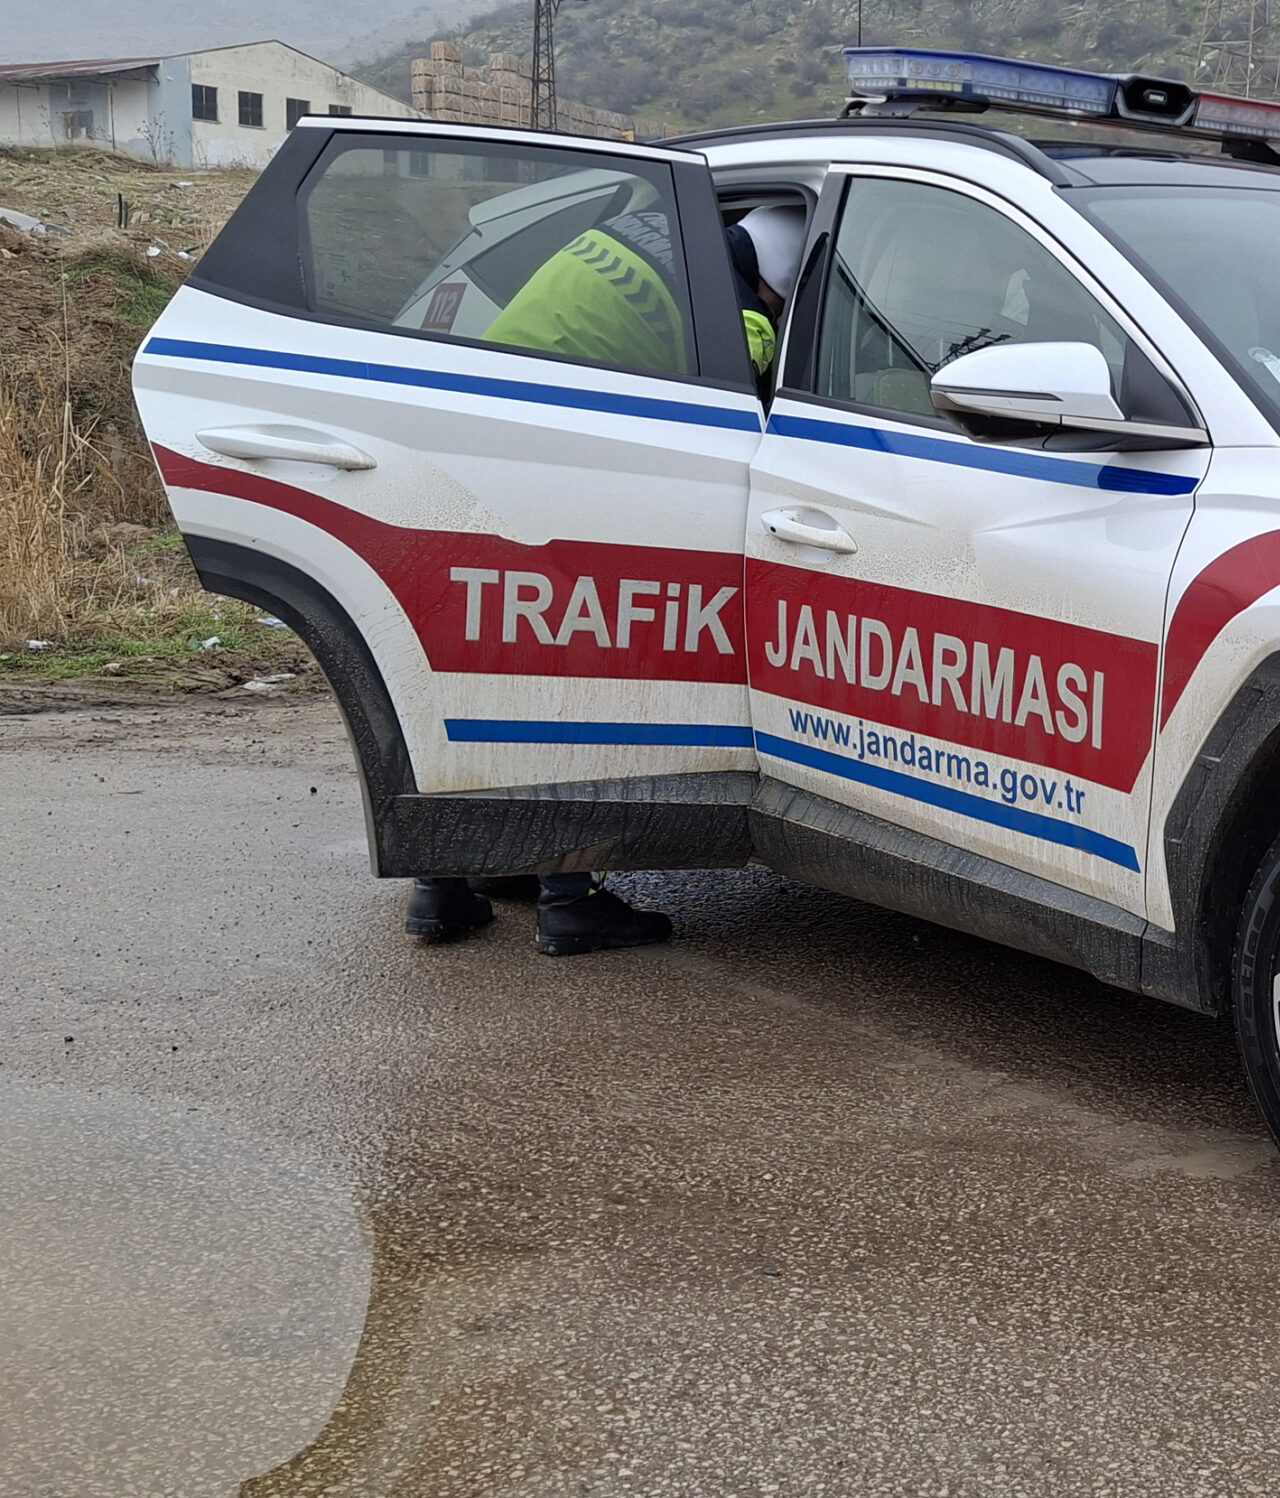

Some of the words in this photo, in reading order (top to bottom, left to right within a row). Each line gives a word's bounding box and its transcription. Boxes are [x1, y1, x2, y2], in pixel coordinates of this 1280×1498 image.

[429, 292, 458, 323] 112
[765, 600, 1105, 750] JANDARMASI
[789, 708, 1086, 814] www.jandarma.gov.tr
